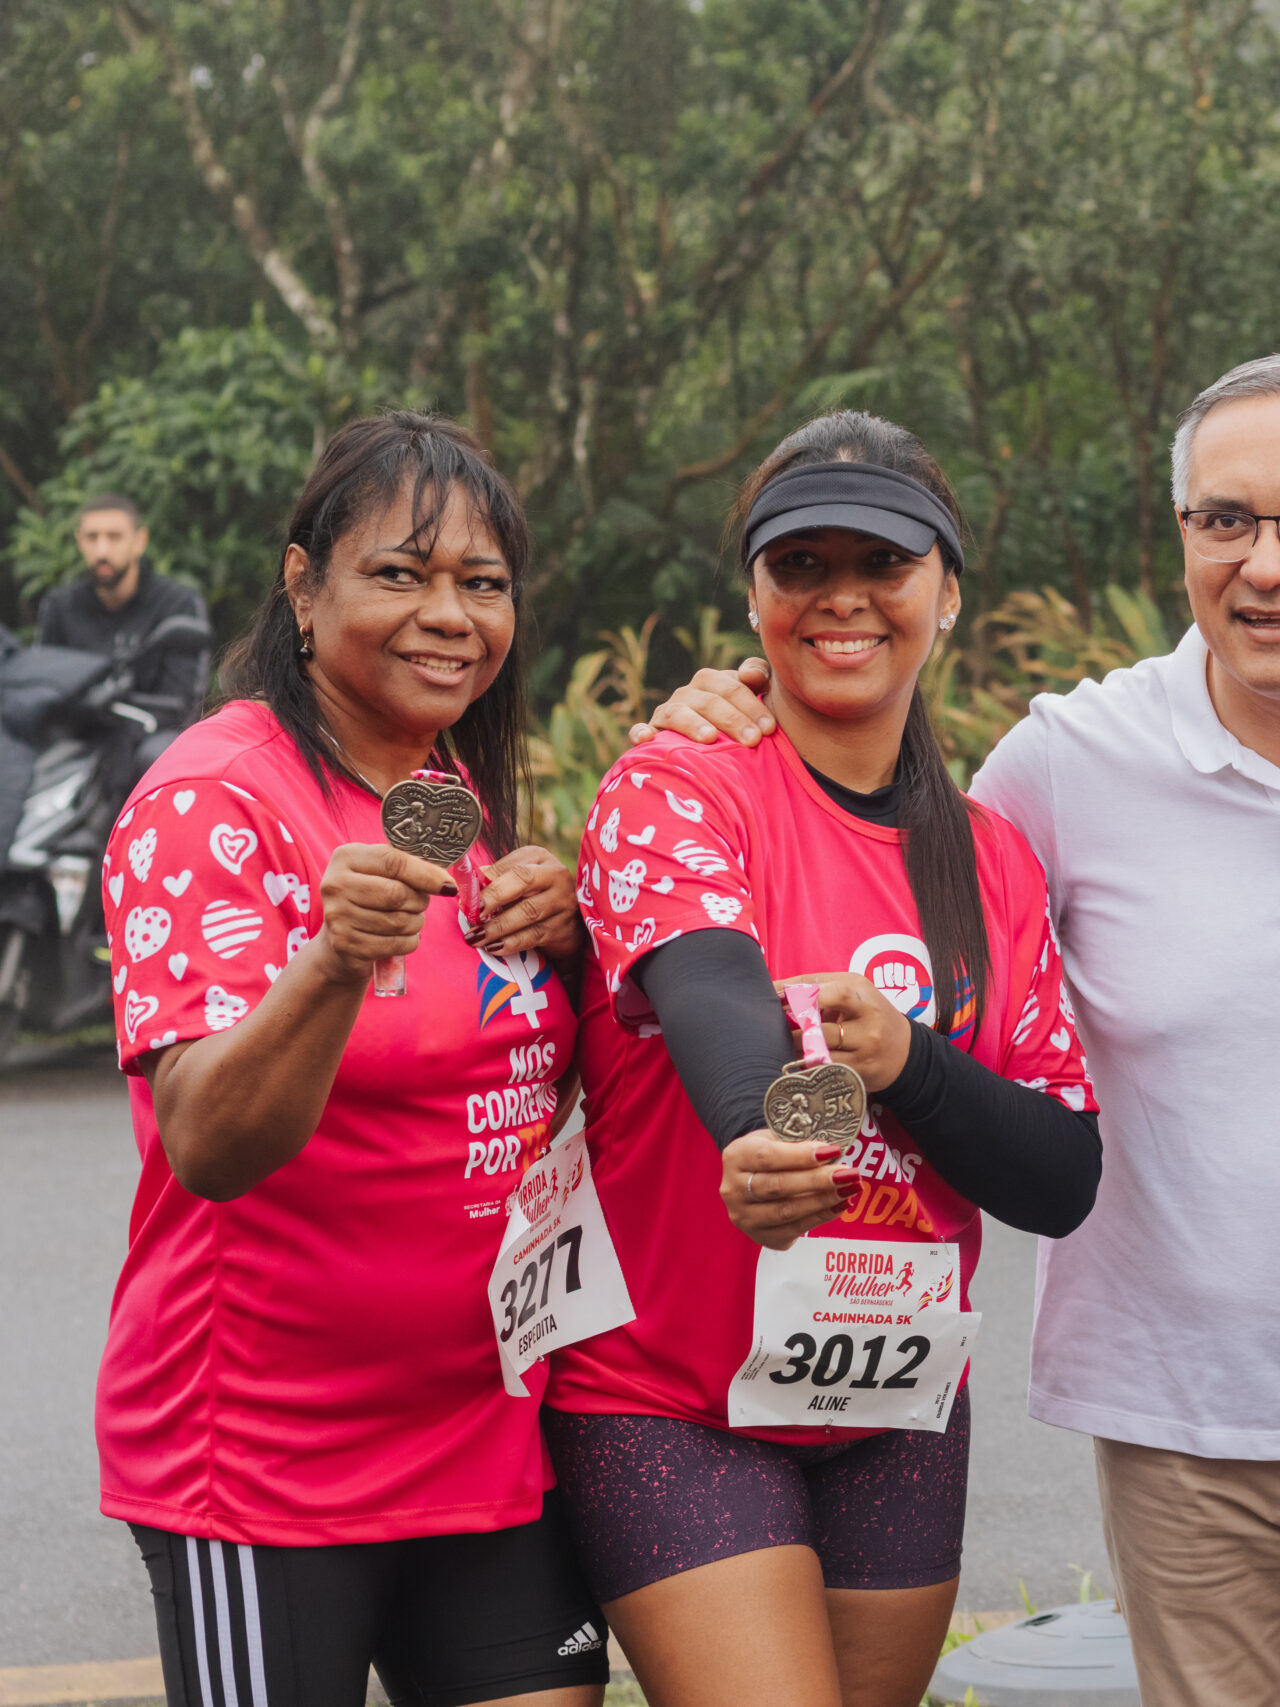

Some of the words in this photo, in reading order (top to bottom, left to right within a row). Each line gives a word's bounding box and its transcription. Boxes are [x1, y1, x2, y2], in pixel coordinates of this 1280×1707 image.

[436, 818, 468, 838] 5K
[508, 1035, 555, 1085] NÓS
[825, 1093, 852, 1117] 5K
[464, 1134, 521, 1179] POR
[469, 1206, 500, 1219] Mulher
[513, 1225, 552, 1265] CAMINHADA
[552, 1215, 561, 1230] 5K
[826, 1251, 893, 1275] CORRIDA
[500, 1225, 583, 1343] 3277
[828, 1273, 896, 1298] Mulher
[813, 1311, 893, 1325] CAMINHADA
[896, 1315, 912, 1325] 5K
[518, 1314, 557, 1355] ESPEDITA
[769, 1332, 931, 1389] 3012
[807, 1395, 851, 1411] ALINE
[557, 1640, 603, 1656] adidas
